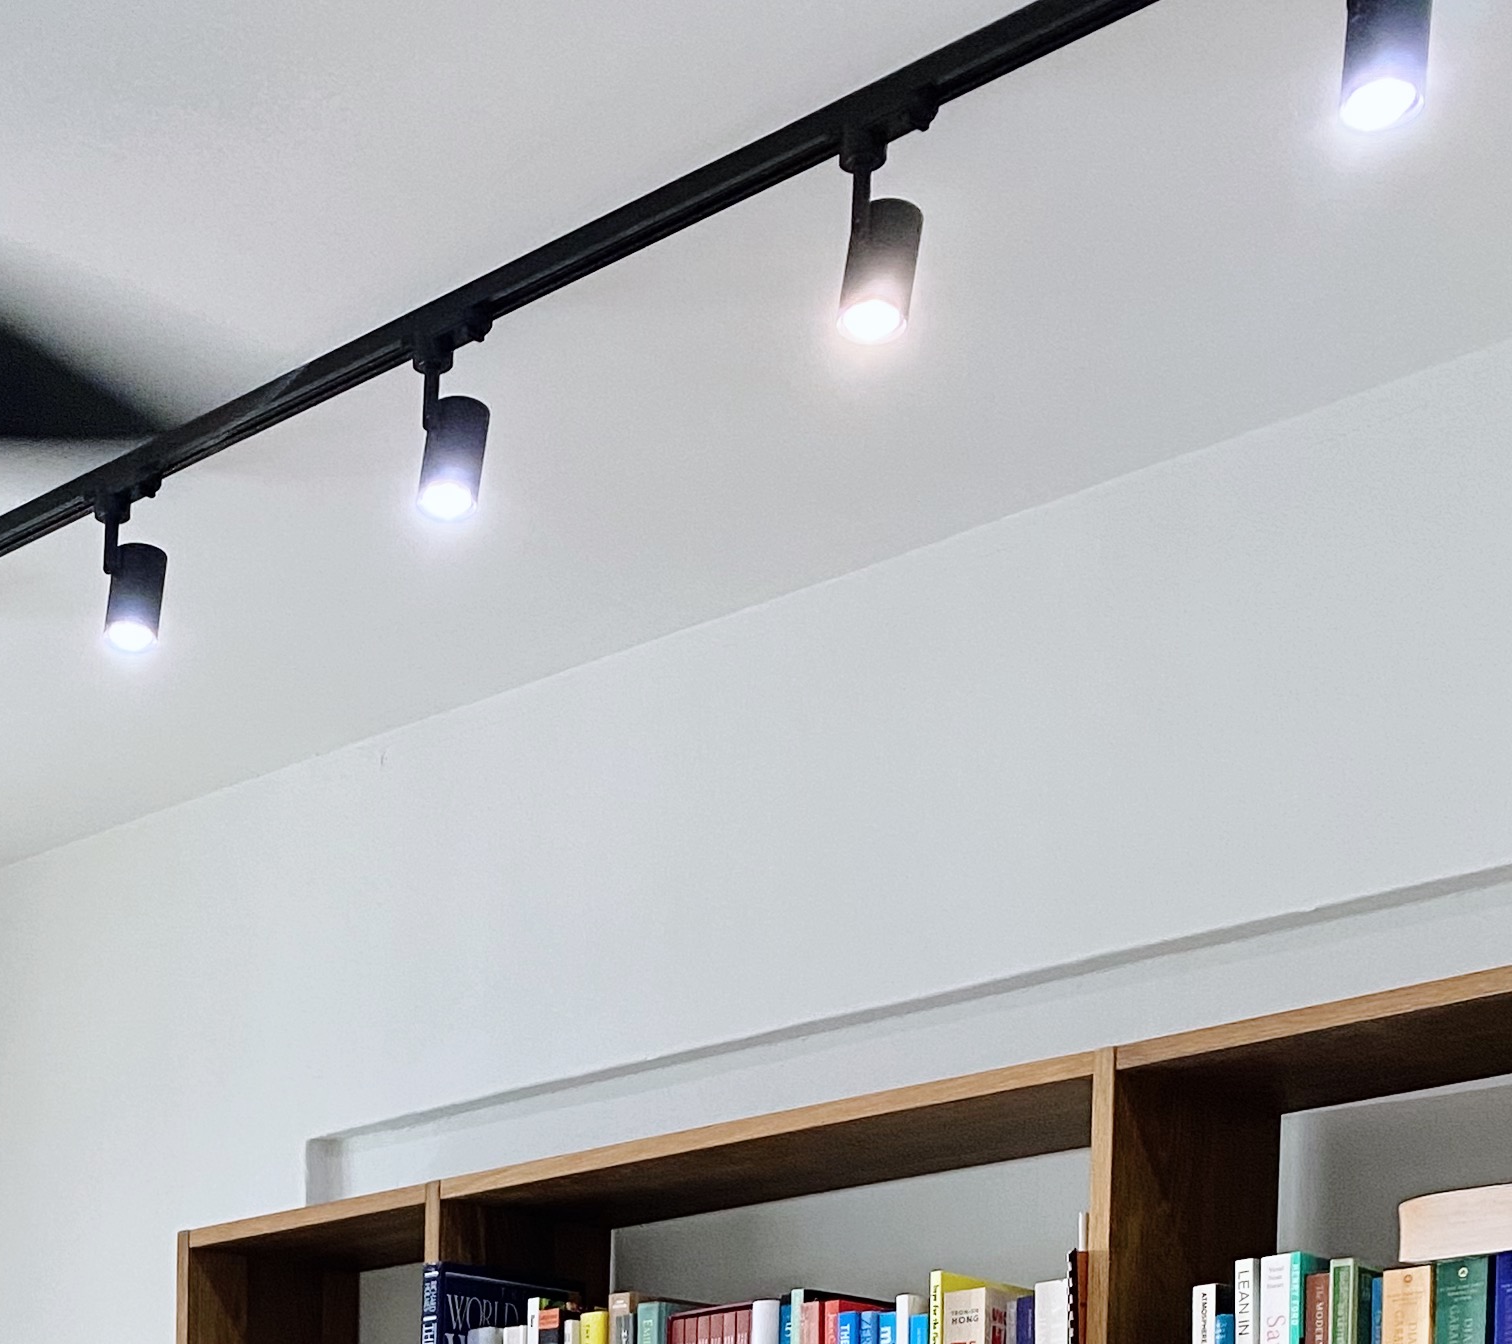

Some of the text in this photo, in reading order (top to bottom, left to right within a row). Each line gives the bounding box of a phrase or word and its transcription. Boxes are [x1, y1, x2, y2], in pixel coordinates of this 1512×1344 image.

[1238, 1270, 1250, 1314] LEAN
[446, 1294, 520, 1332] WORLD
[951, 1315, 980, 1325] HONG
[1200, 1292, 1208, 1344] ATMOSPHERE
[1238, 1318, 1250, 1336] IN
